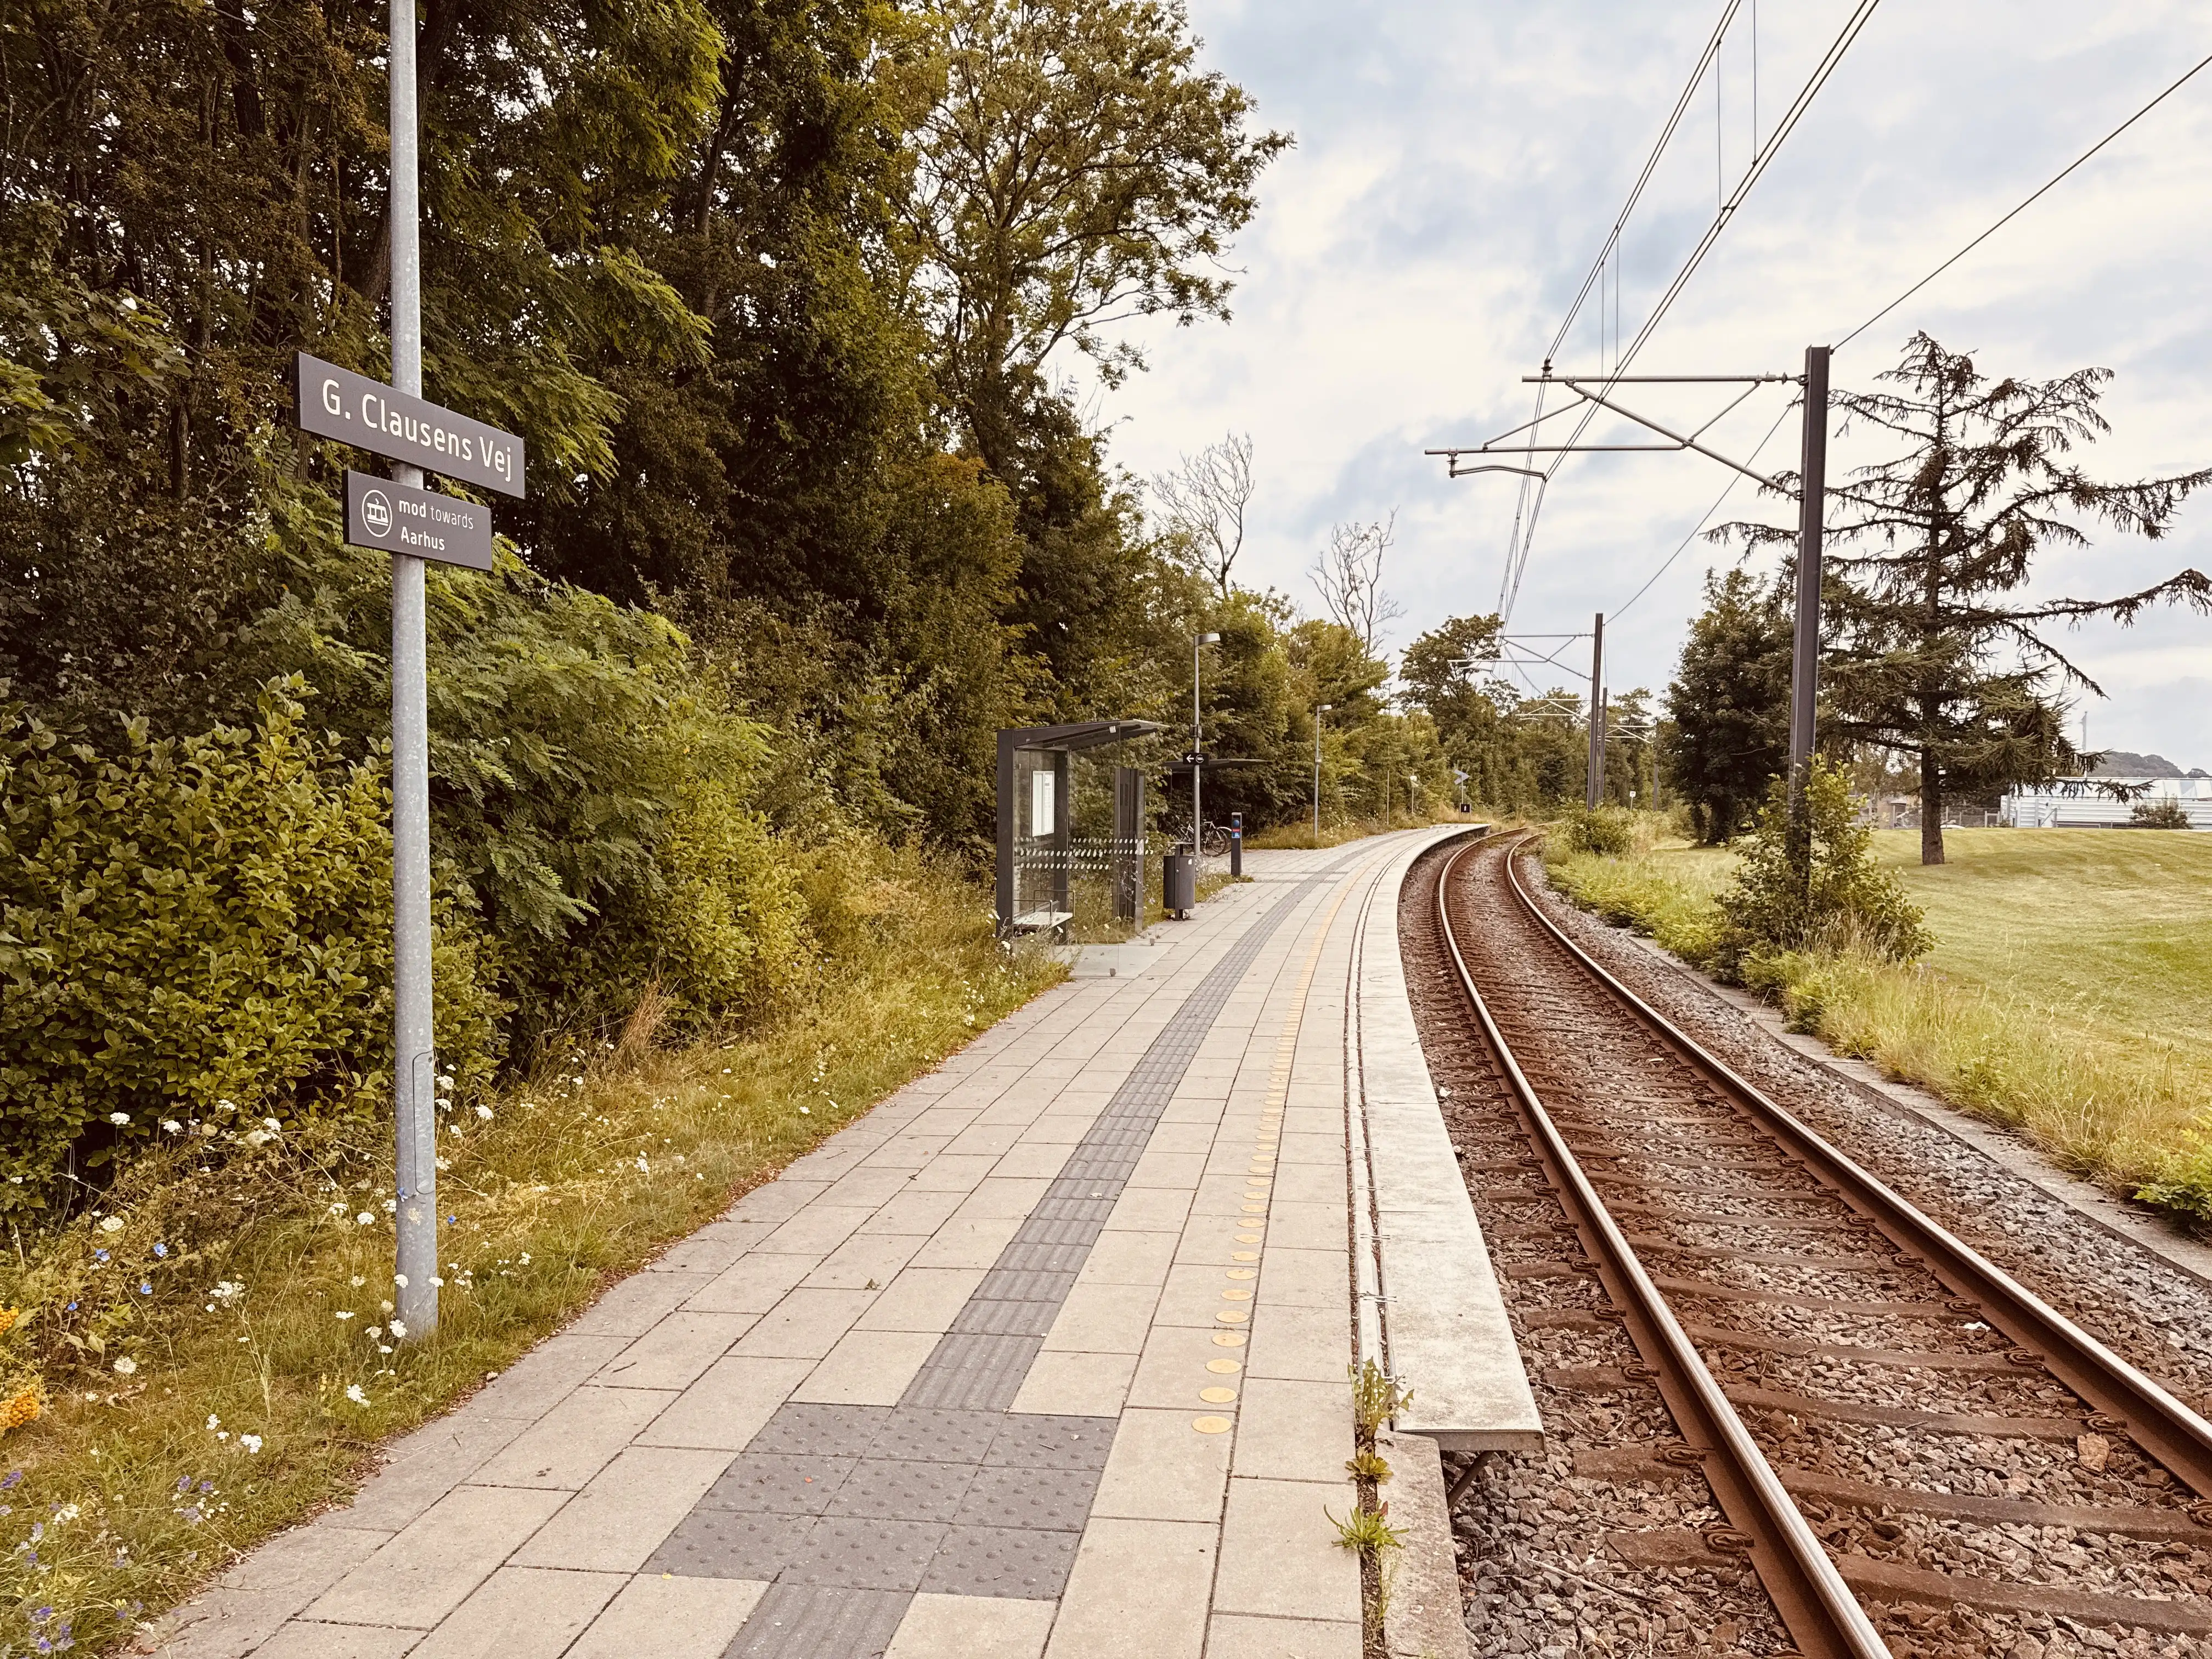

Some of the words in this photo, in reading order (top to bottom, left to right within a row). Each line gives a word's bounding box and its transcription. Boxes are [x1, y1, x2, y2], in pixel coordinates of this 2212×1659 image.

[323, 379, 351, 420] G.
[362, 393, 472, 461] Clausens
[479, 436, 511, 482] Vej
[399, 500, 426, 518] mod
[430, 505, 474, 529] towards
[400, 526, 445, 551] Aarhus
